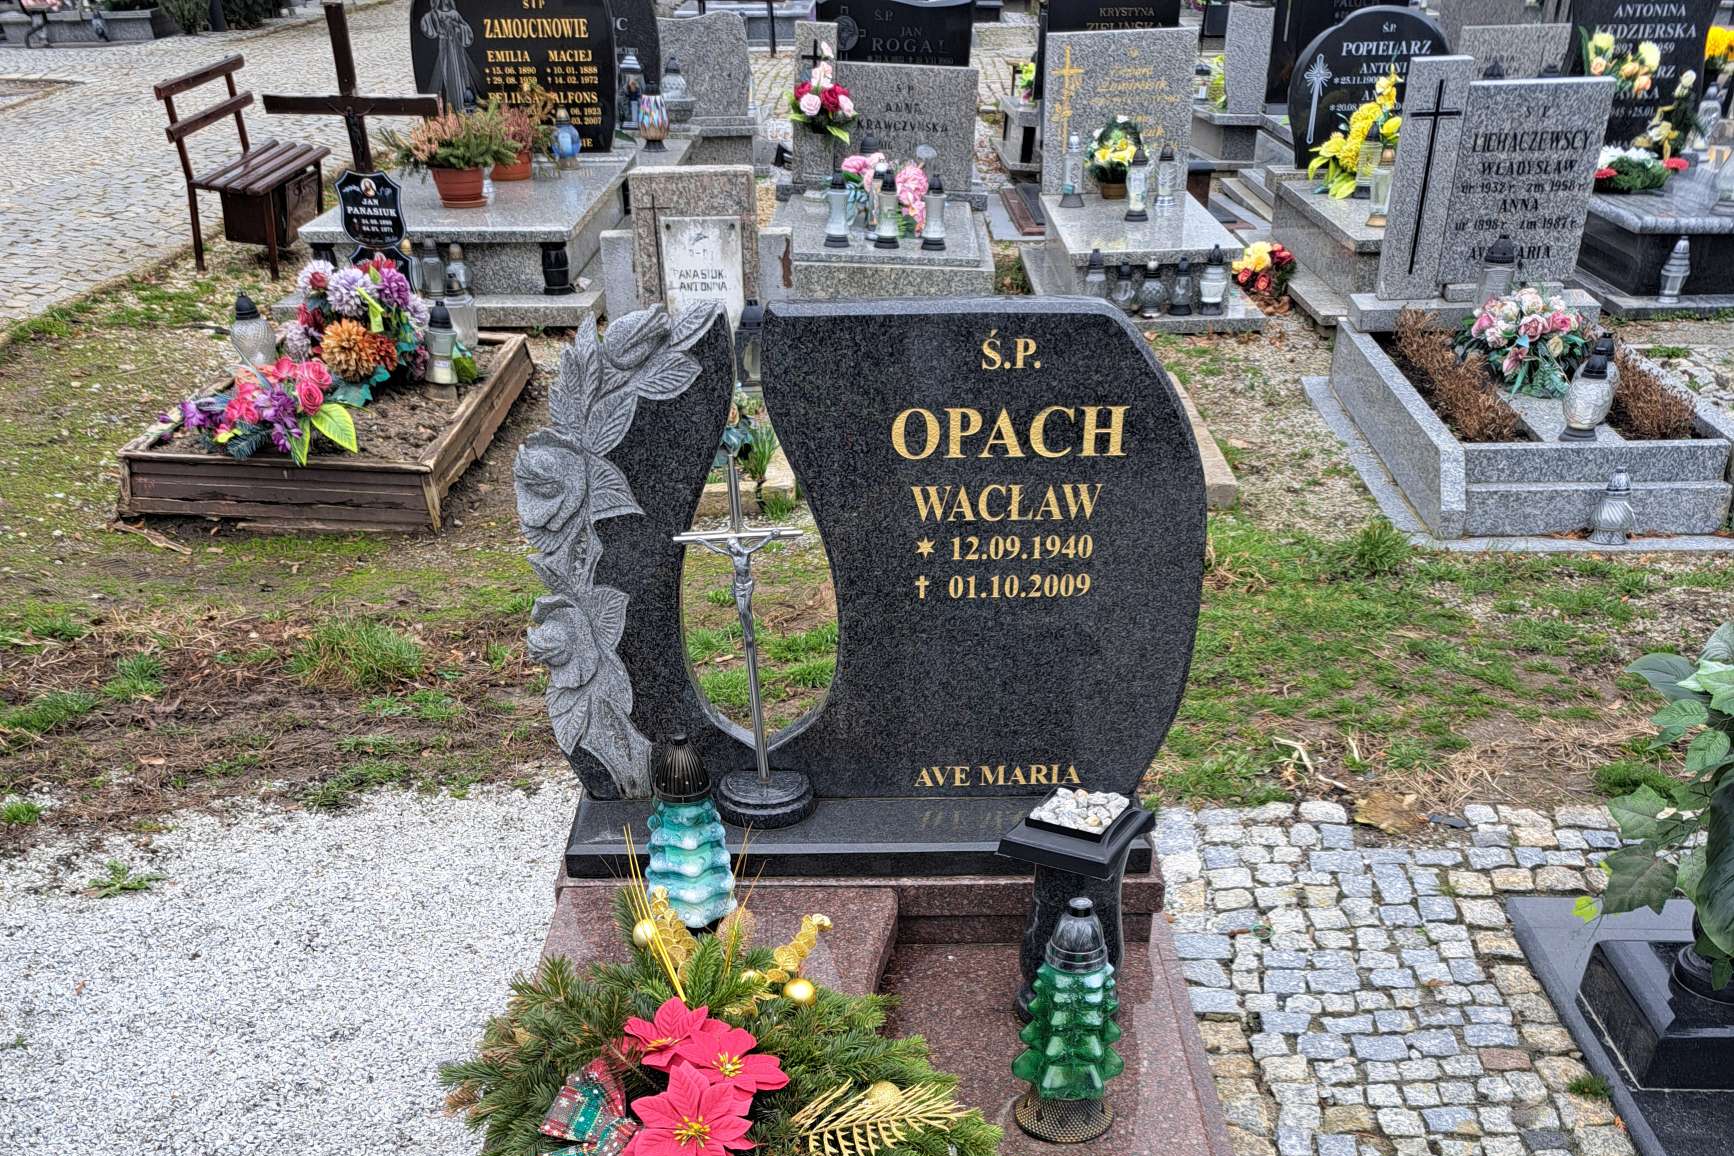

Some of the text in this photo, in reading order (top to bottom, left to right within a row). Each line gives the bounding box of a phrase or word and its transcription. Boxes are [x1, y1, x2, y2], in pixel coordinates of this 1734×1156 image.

[1099, 7, 1156, 17] KRYSTYNA
[1614, 4, 1687, 17] ANTONINA
[483, 18, 589, 39] ZAMOJCINOWIE
[486, 50, 531, 62] EMILIA
[548, 50, 593, 62] MACIEJ
[1341, 40, 1432, 57] POPIELARZ
[346, 206, 397, 217] PANASIUK
[1500, 199, 1539, 213] ANNA
[981, 329, 1041, 370] Ś.P.
[891, 405, 1131, 460] OPACH
[911, 483, 1103, 522] WACŁAW
[950, 534, 1093, 560] 12.09.1940
[948, 573, 1092, 598] 01.10.2009
[913, 763, 1084, 787] AVE MARIA
